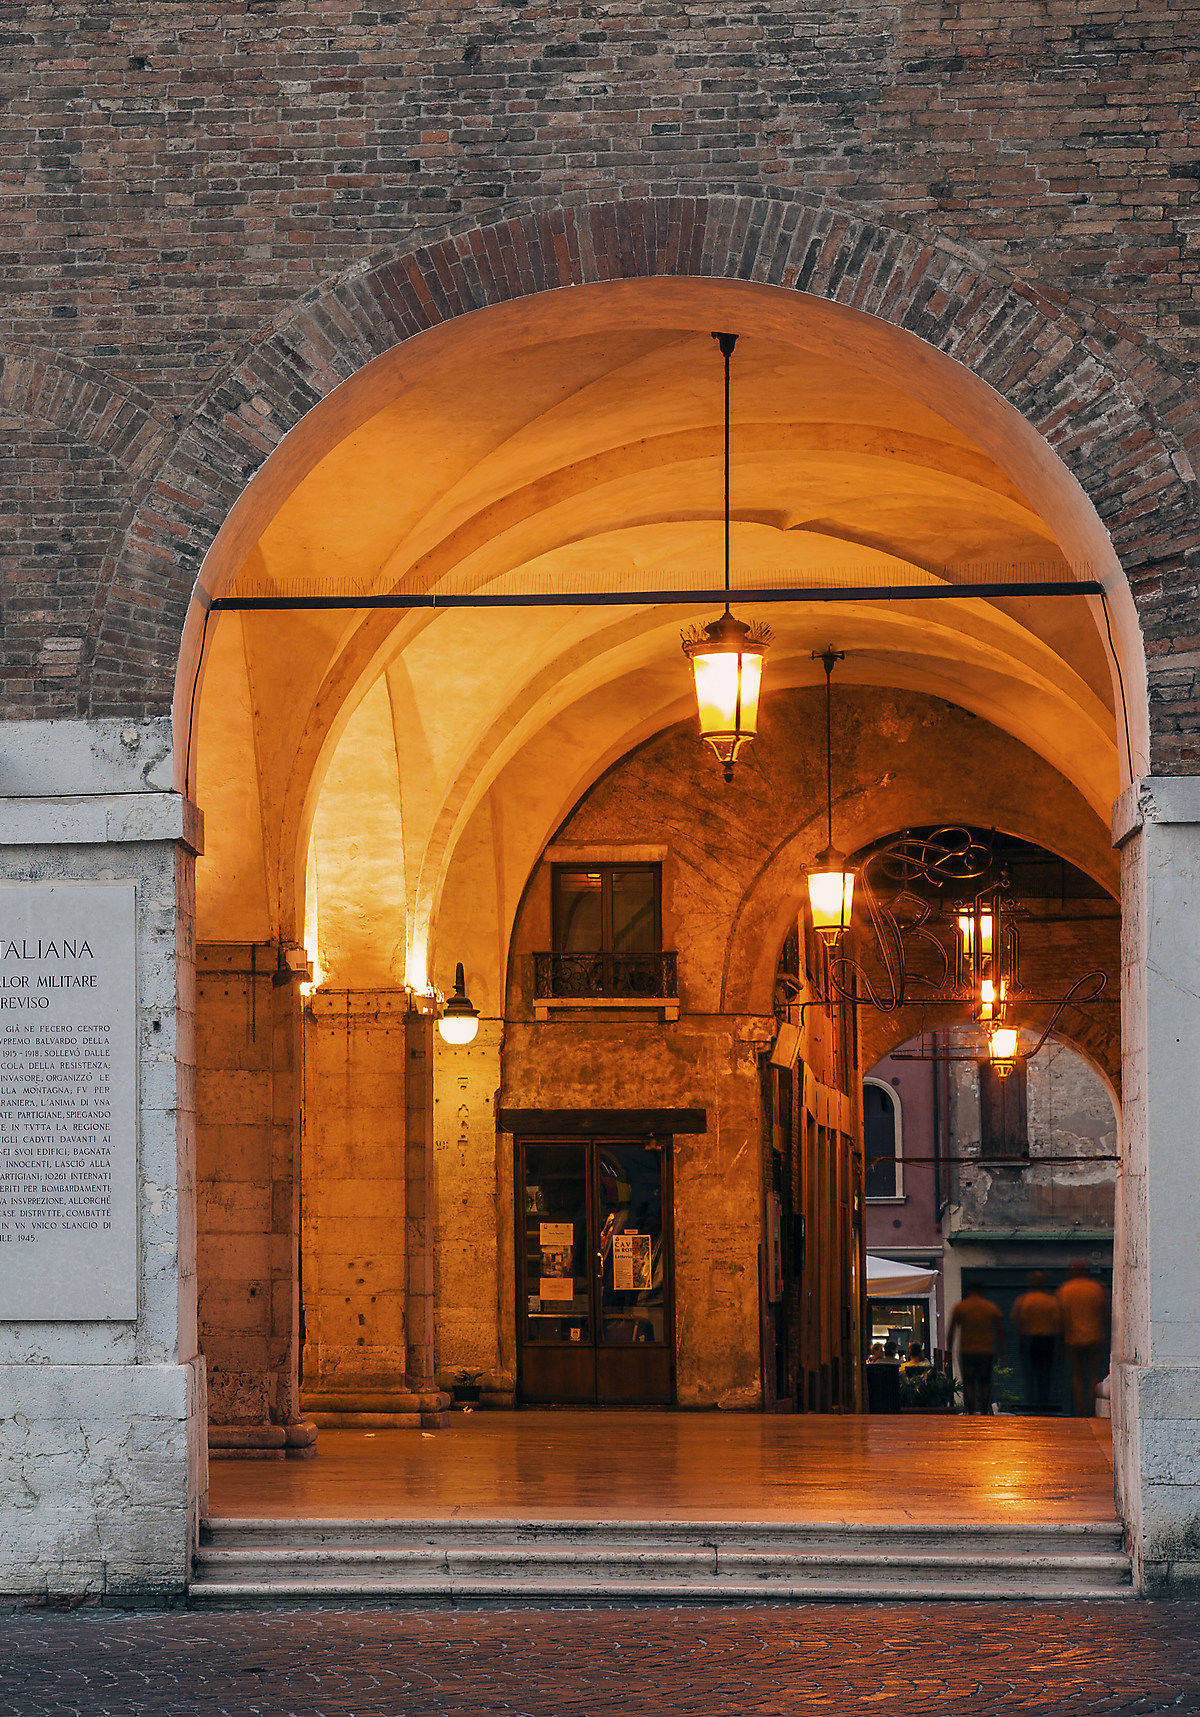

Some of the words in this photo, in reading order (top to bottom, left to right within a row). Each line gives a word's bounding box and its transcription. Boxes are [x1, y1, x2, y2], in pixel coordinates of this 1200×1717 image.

[37, 976, 98, 987] MILITARE
[24, 1025, 34, 1033] NE
[40, 1025, 72, 1033] FECERO
[77, 1024, 110, 1032] CENTRO
[36, 1037, 77, 1045] BALVARDO
[83, 1037, 109, 1045] DELLA
[29, 1061, 55, 1069] DELLA
[60, 1062, 110, 1070] RESISTENZA;
[41, 1099, 75, 1107] L'ANIMA
[81, 1098, 88, 1106] DI
[94, 1098, 110, 1106] VNA
[18, 1111, 64, 1119] PARTIGIANE,
[66, 1110, 111, 1118] SPIEGANDO
[12, 1123, 19, 1131] IN
[24, 1123, 51, 1131] TVTTA
[56, 1123, 67, 1131] LA
[73, 1123, 110, 1131] REGIONE
[23, 1135, 54, 1143] CADVTI
[60, 1135, 95, 1143] DAVANTI
[103, 1135, 110, 1143] AI
[15, 1148, 33, 1156] SVOI
[37, 1148, 69, 1156] EDIFICI;
[74, 1147, 111, 1155] BAGNATA
[6, 1160, 51, 1168] INNOCENTI,
[90, 1160, 111, 1168] ALLA
[45, 1172, 66, 1180] 10261
[71, 1172, 111, 1180] INTERNATI
[24, 1184, 37, 1192] PER
[11, 1197, 66, 1205] INSVRREZIONE,
